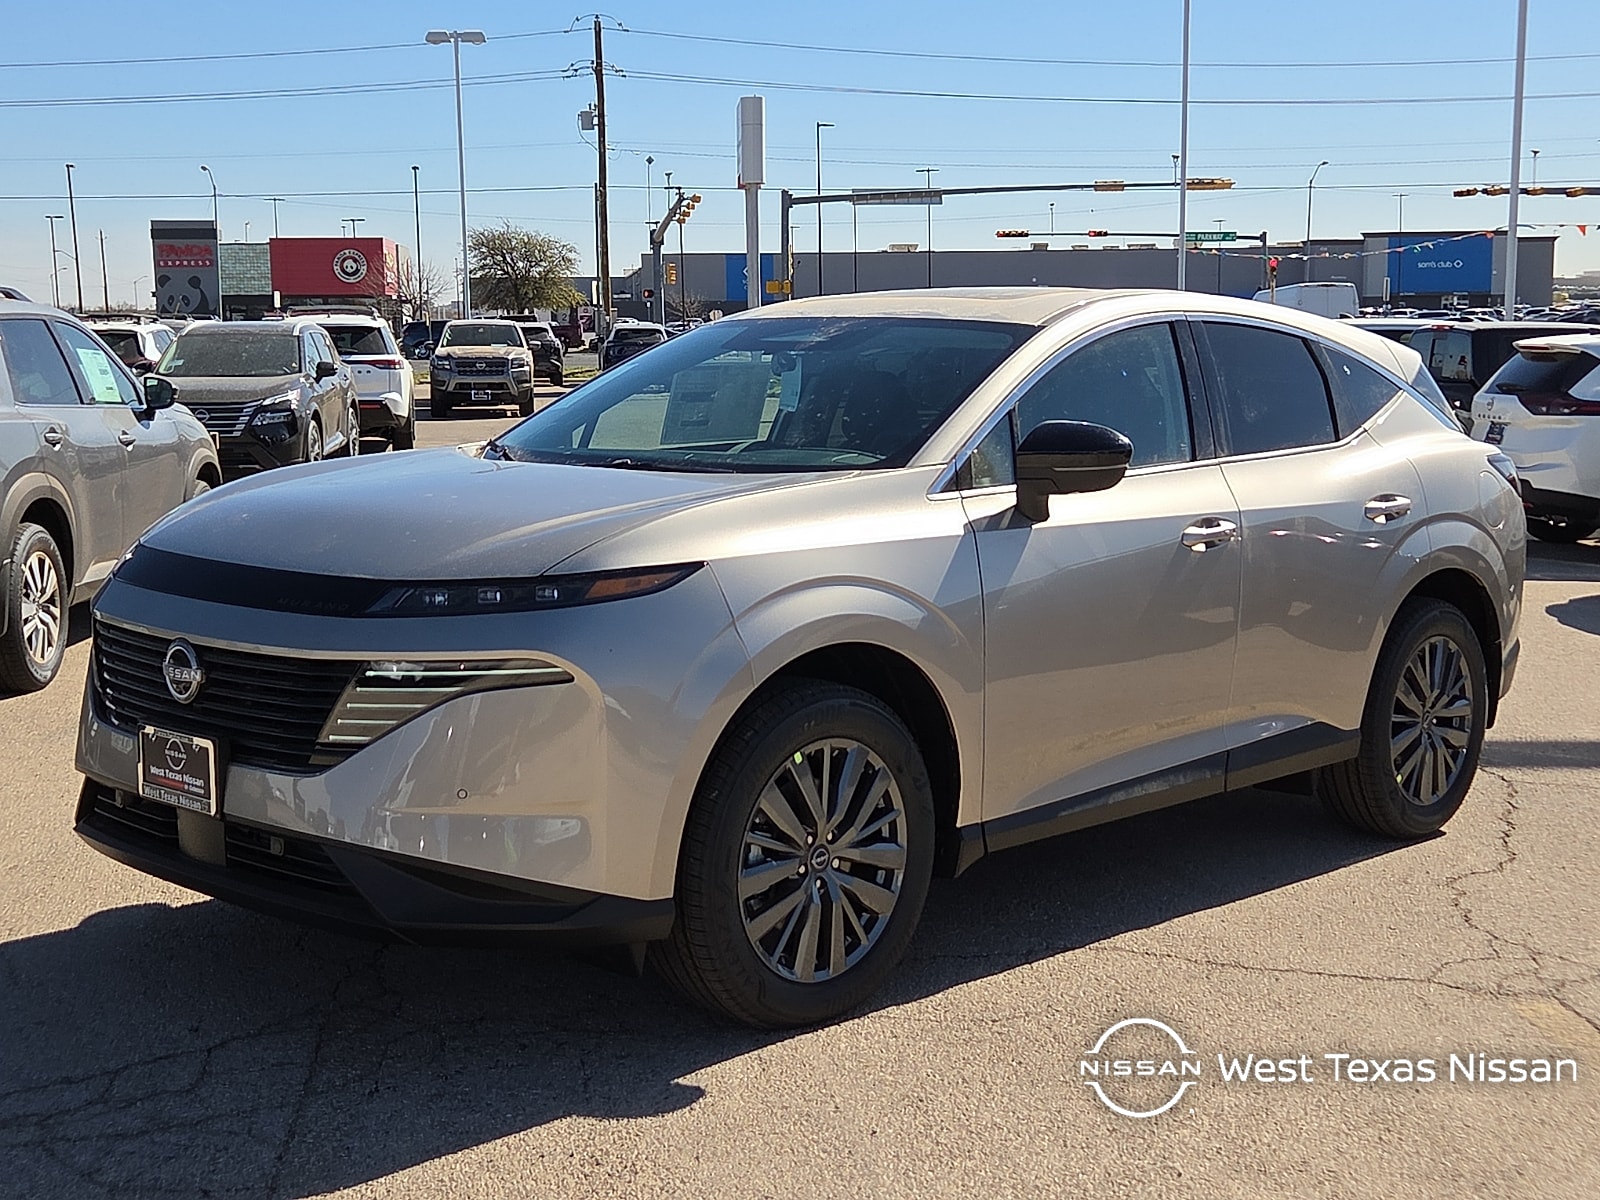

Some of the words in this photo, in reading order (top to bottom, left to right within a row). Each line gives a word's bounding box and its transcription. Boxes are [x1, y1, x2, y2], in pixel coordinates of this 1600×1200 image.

[1197, 233, 1224, 241] PARKWAY
[157, 243, 213, 258] PANDA
[1417, 261, 1437, 269] sam's
[1437, 260, 1453, 268] club
[164, 749, 187, 760] NISSAN
[149, 764, 165, 778] West
[165, 769, 182, 782] Texas
[183, 773, 205, 787] Nissan
[143, 786, 159, 798] West
[160, 789, 178, 803] Texas
[179, 794, 201, 810] Nissan
